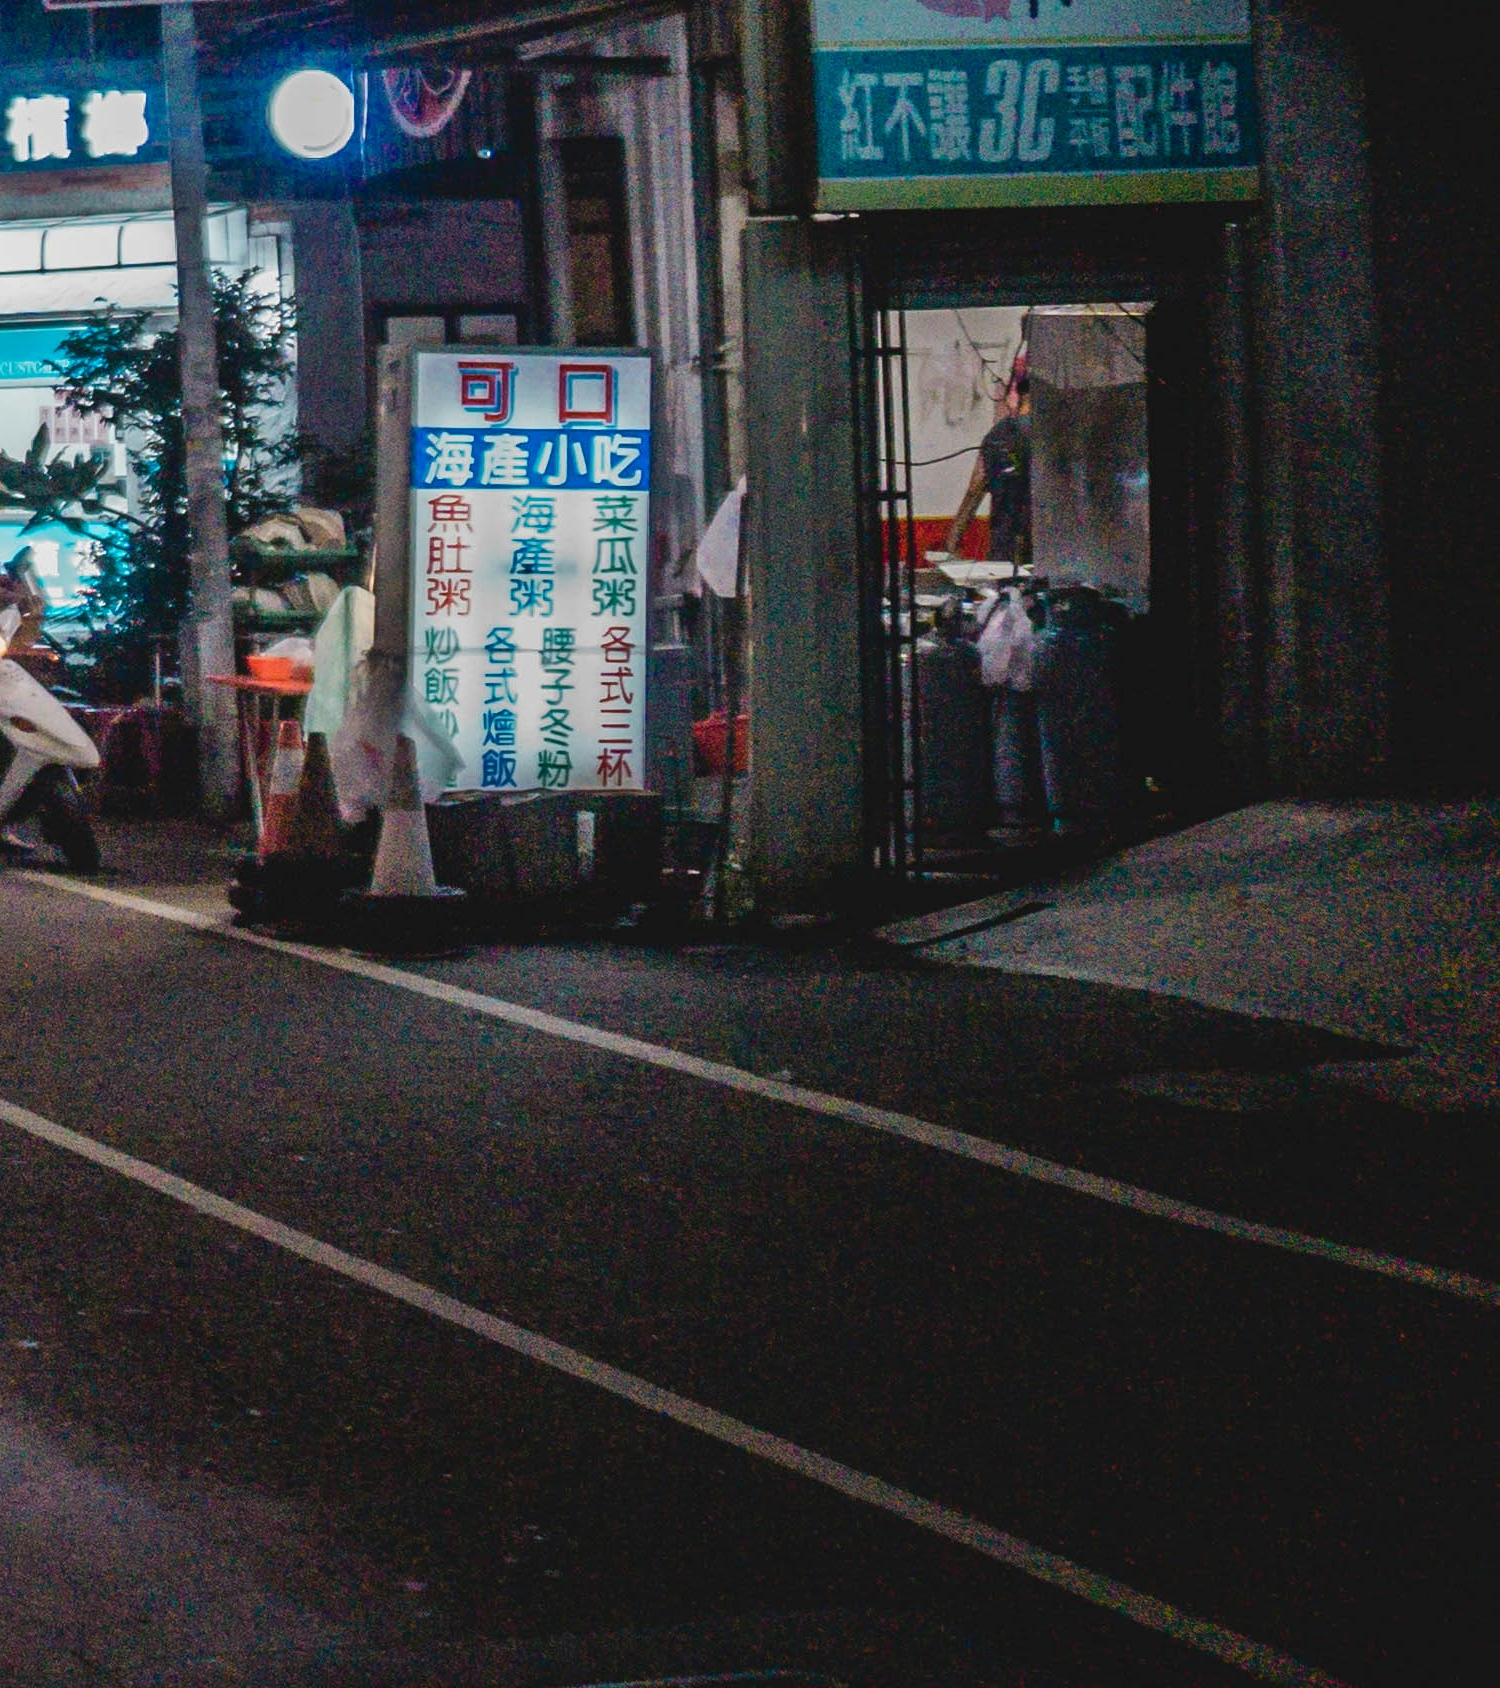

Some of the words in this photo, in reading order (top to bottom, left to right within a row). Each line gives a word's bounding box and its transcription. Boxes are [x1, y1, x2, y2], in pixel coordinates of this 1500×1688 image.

[840, 69, 973, 162] 紅不讓
[977, 58, 1061, 163] 3C
[456, 360, 619, 428] 可口
[424, 432, 642, 487] 海產小吃
[426, 494, 473, 617] 魚肚粥
[509, 494, 556, 617] 海產粥
[591, 495, 639, 617] 菜瓜粥
[481, 626, 518, 788] 各式燴飯
[537, 627, 577, 789] 腰子冬粉
[596, 626, 638, 788] 各式三杯
